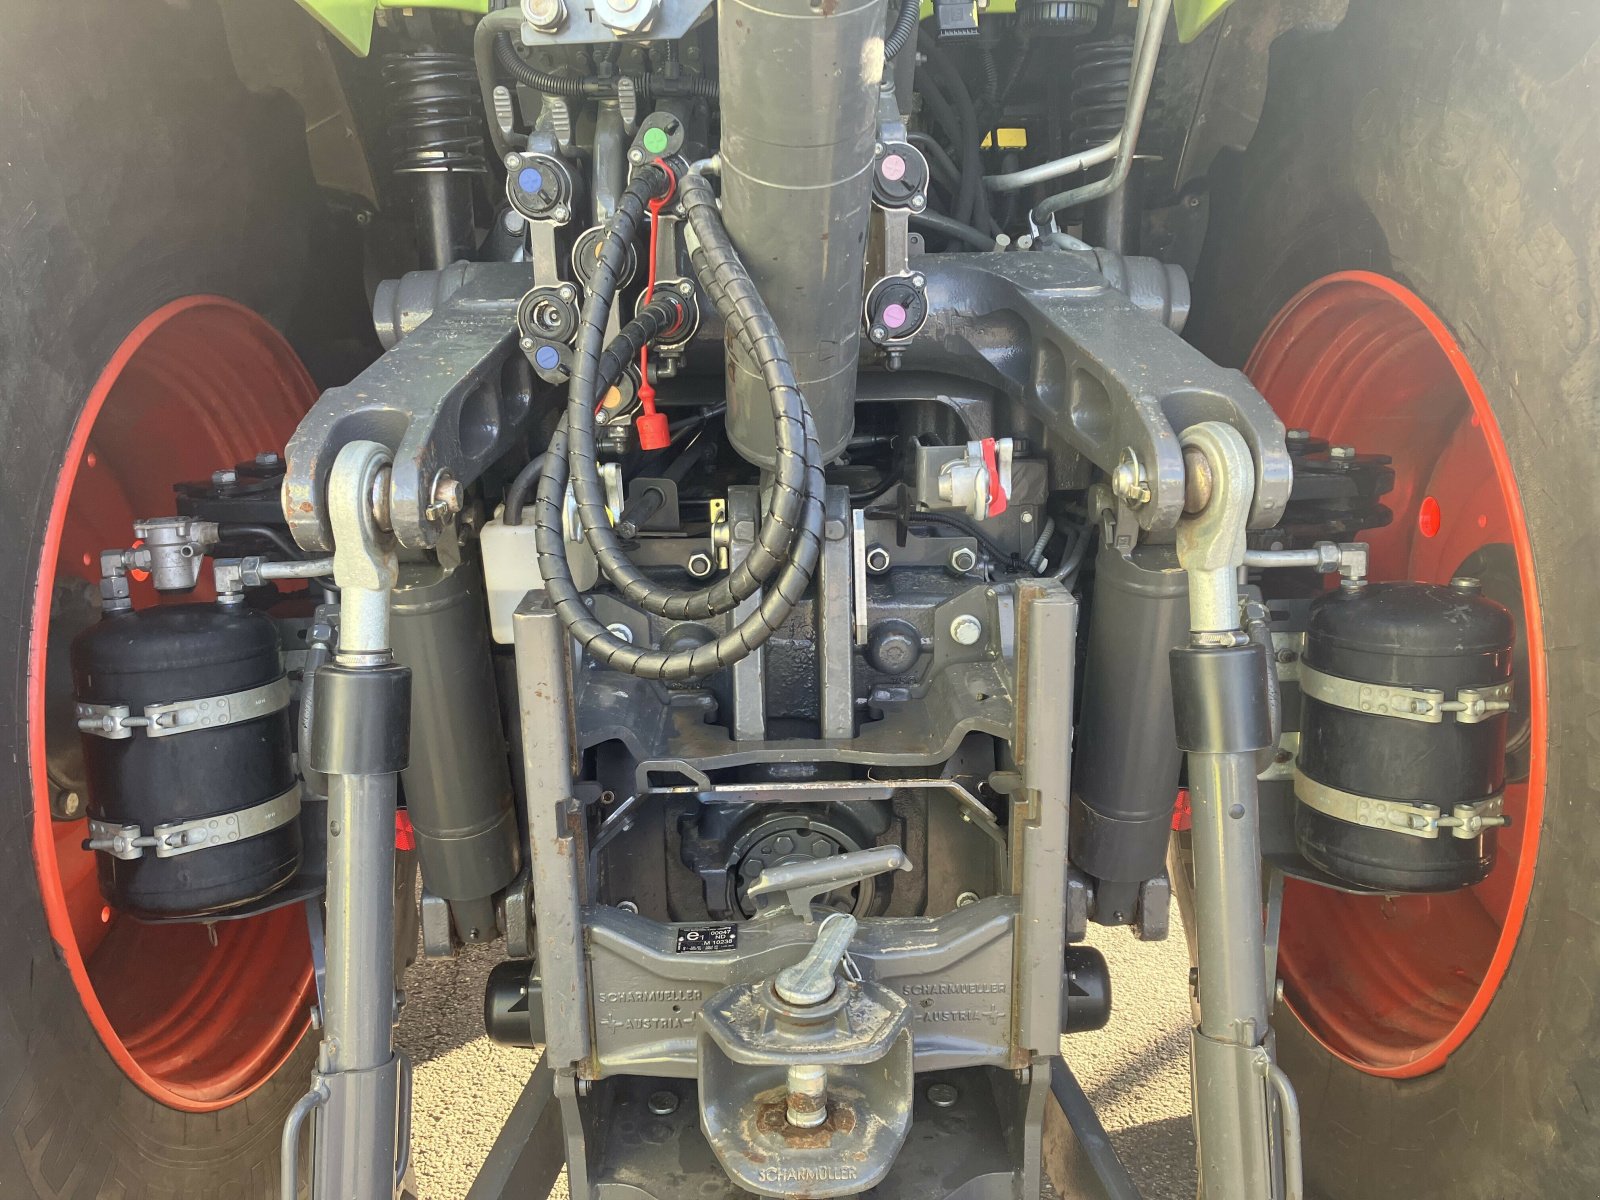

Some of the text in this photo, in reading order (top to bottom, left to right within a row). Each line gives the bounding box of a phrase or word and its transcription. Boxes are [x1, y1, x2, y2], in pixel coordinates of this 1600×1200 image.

[584, 7, 595, 23] T
[599, 989, 703, 1003] SCHARMUELLER
[902, 982, 1007, 996] SCHARMUELLER
[923, 1009, 981, 1022] AUSTRIA
[626, 1017, 684, 1030] AUSTRIA
[758, 1165, 858, 1182] SCHARMÜLLER
